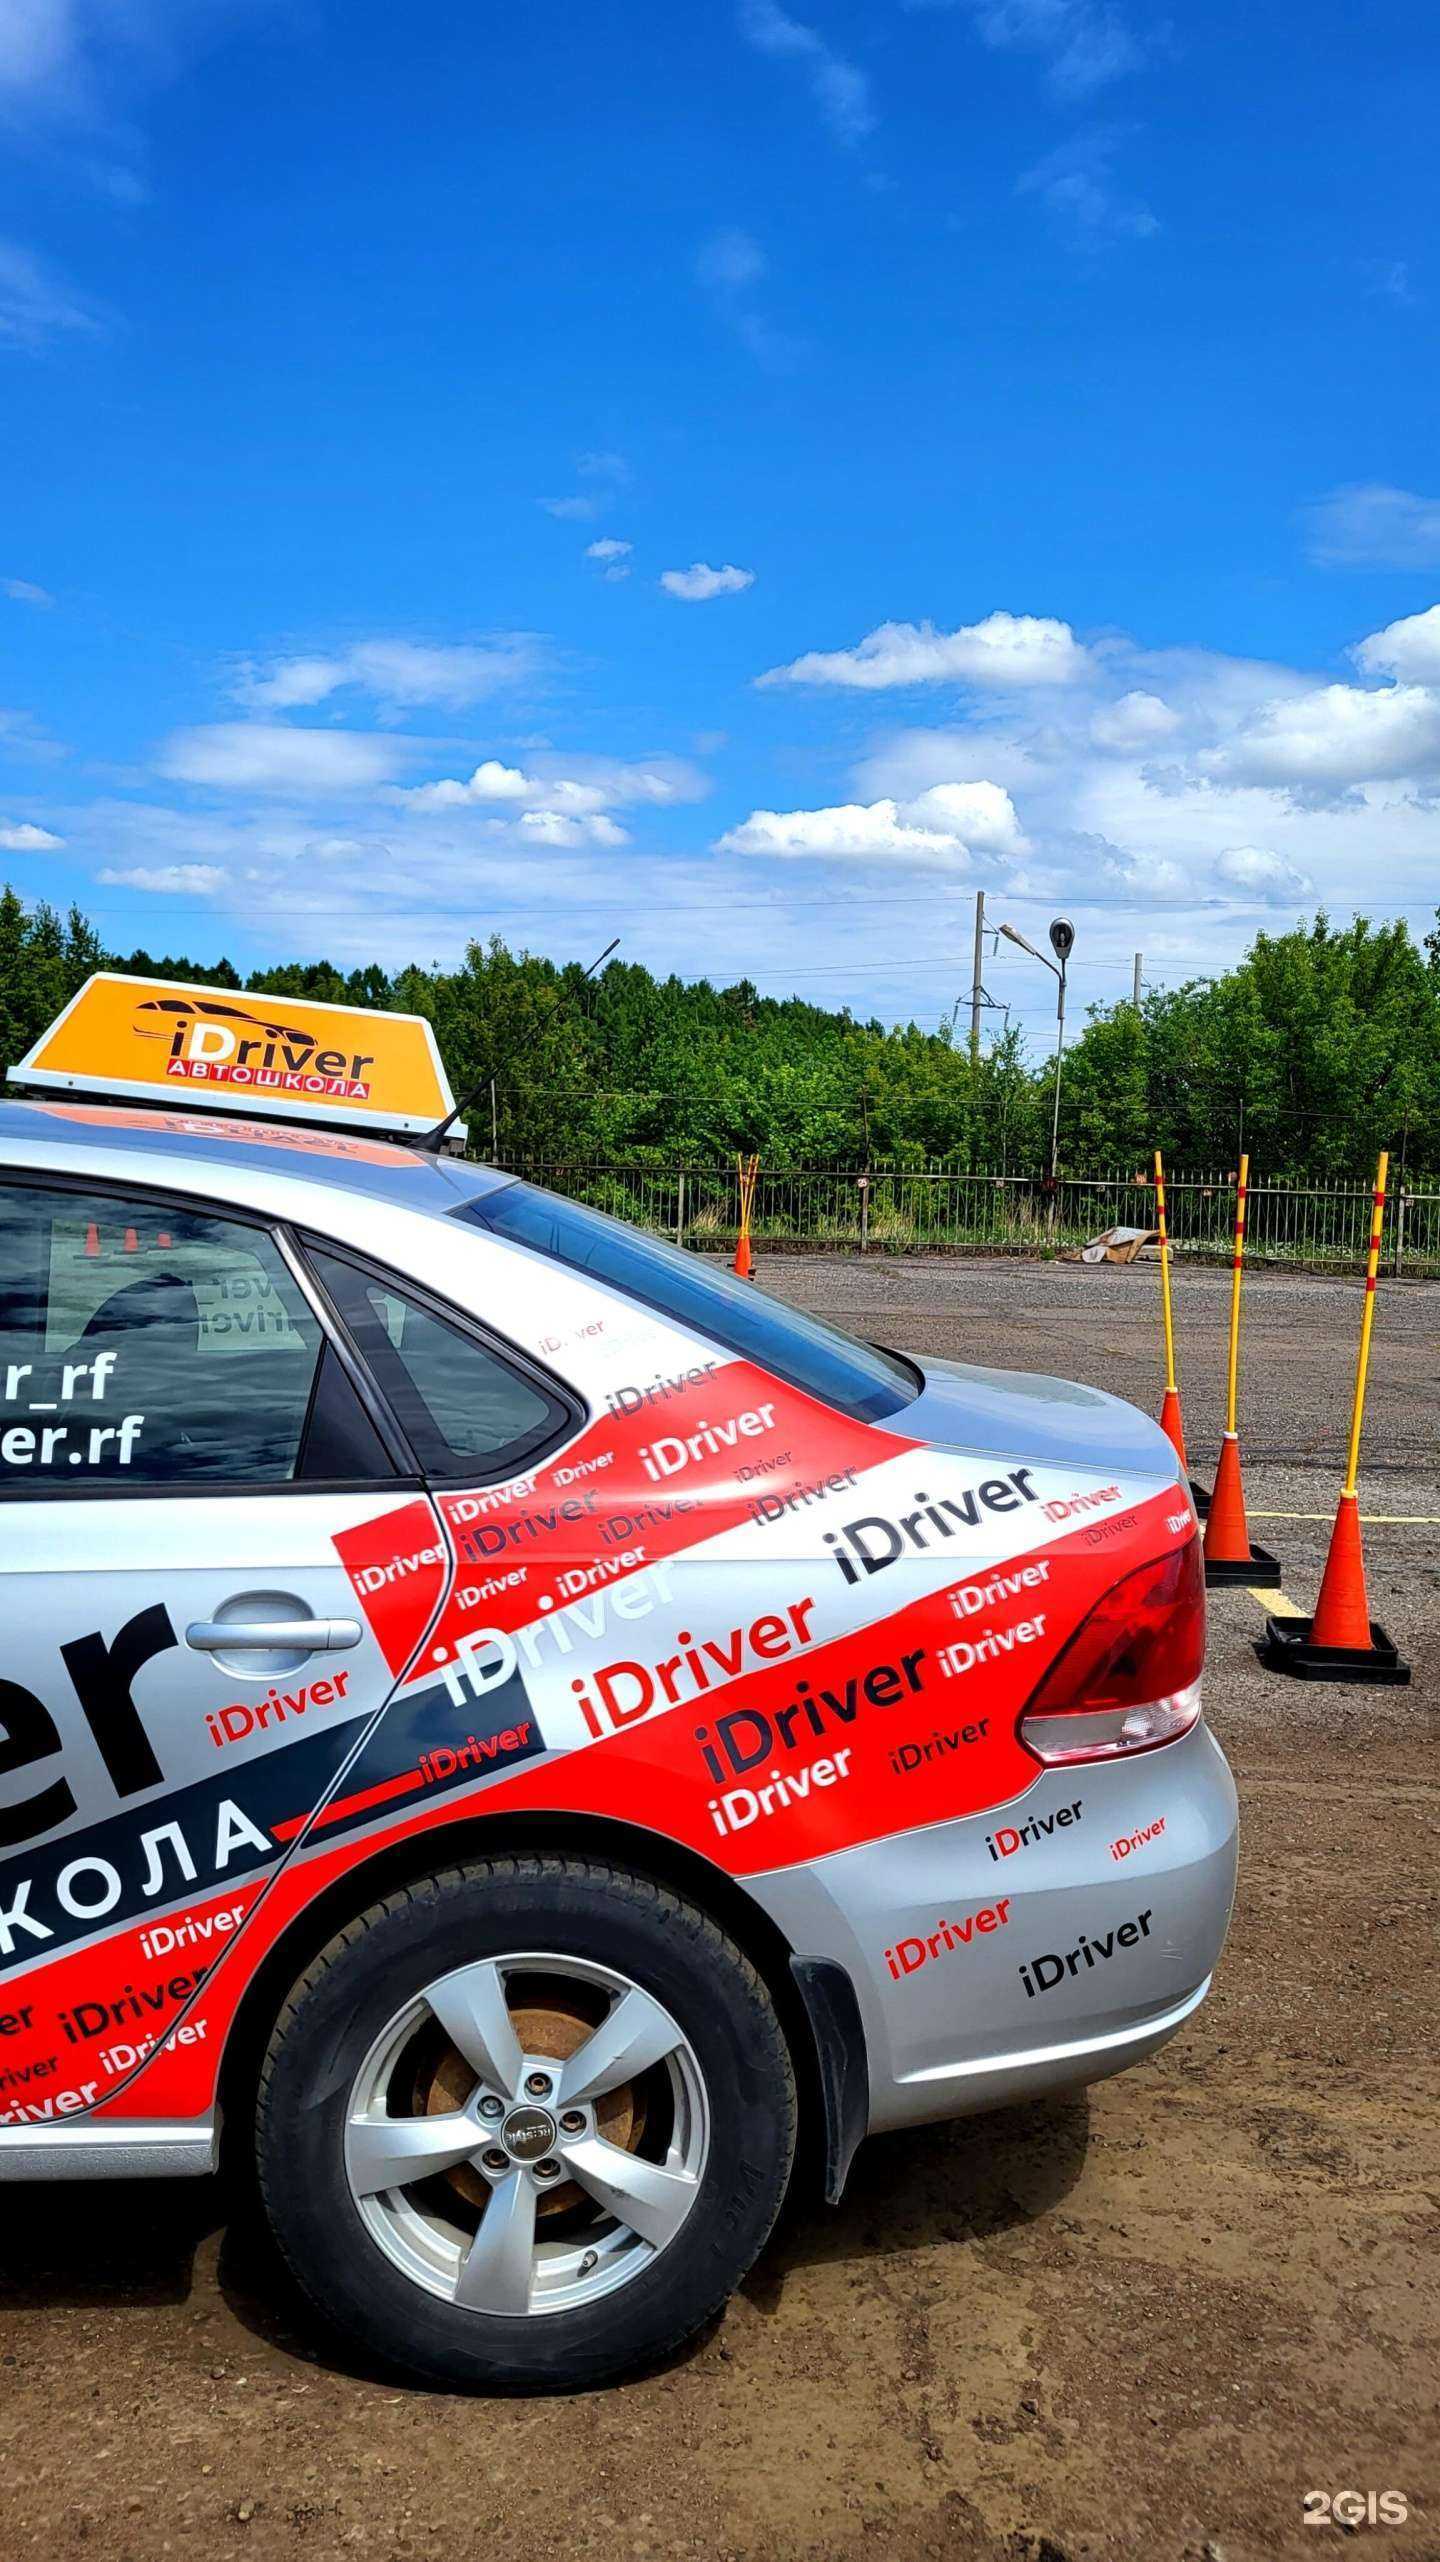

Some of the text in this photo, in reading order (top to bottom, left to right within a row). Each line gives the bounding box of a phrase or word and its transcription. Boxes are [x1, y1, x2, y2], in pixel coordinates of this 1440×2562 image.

[168, 1059, 369, 1098] АВТОШКОЛА
[171, 1021, 374, 1080] iDriver
[538, 1321, 604, 1355] iDver
[605, 1360, 716, 1421] iDriver
[553, 1452, 614, 1487] iDriver
[637, 1403, 775, 1481] iDriver
[733, 1451, 792, 1484] iDriver
[447, 1475, 537, 1525] iDriver
[460, 1489, 600, 1562] iDriver
[747, 1465, 857, 1526] iDriver
[1041, 1484, 1125, 1524] iDriver
[822, 1468, 1039, 1585] iDriver
[1081, 1513, 1138, 1547] iDriver
[353, 1541, 446, 1596] iDriver
[454, 1567, 528, 1610] iDriver
[555, 1546, 646, 1598] iDriver
[947, 1560, 1051, 1620] iDriver
[432, 1561, 675, 1708] iDriver
[936, 1613, 1046, 1678] iDriver
[571, 1597, 815, 1739] iDriver
[205, 1670, 349, 1748] iDriver
[695, 1649, 925, 1784] iDriver
[418, 1721, 532, 1785] iDriver
[889, 1718, 990, 1775] iDriver
[707, 1748, 852, 1837] iDriver
[985, 1800, 1082, 1861] iDriver
[1110, 1817, 1166, 1861] iDriver
[139, 1904, 244, 1960] iDriver
[884, 1898, 1011, 1981] iDriver
[1018, 1909, 1152, 1998] iDriver
[58, 1966, 209, 2044] iDriver
